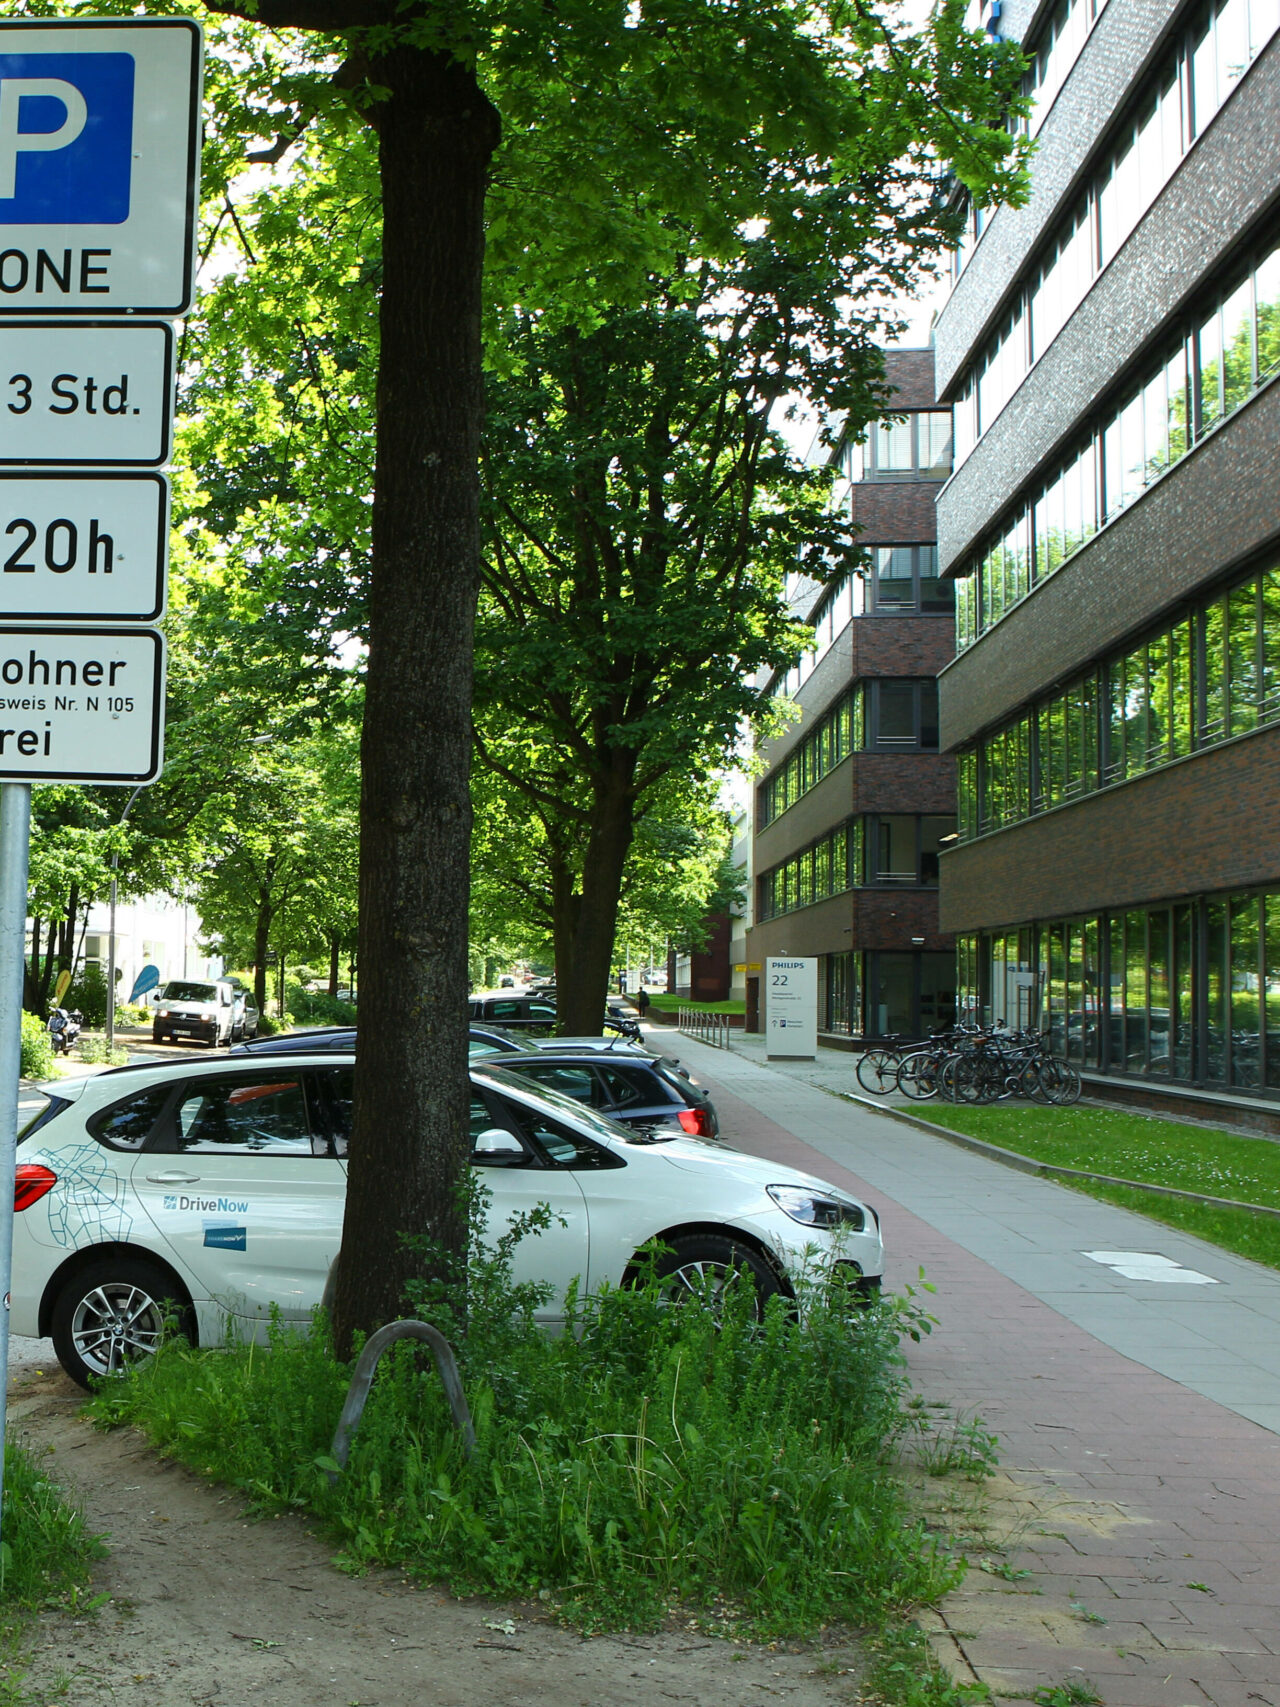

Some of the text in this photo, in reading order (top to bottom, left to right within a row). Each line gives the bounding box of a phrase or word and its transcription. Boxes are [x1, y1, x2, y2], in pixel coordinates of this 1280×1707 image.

[7, 373, 140, 415] 3 Std.
[54, 695, 78, 711] Nr.
[86, 696, 99, 712] N
[107, 697, 134, 713] 105
[772, 974, 788, 986] 22
[179, 1196, 249, 1213] DriveNow
